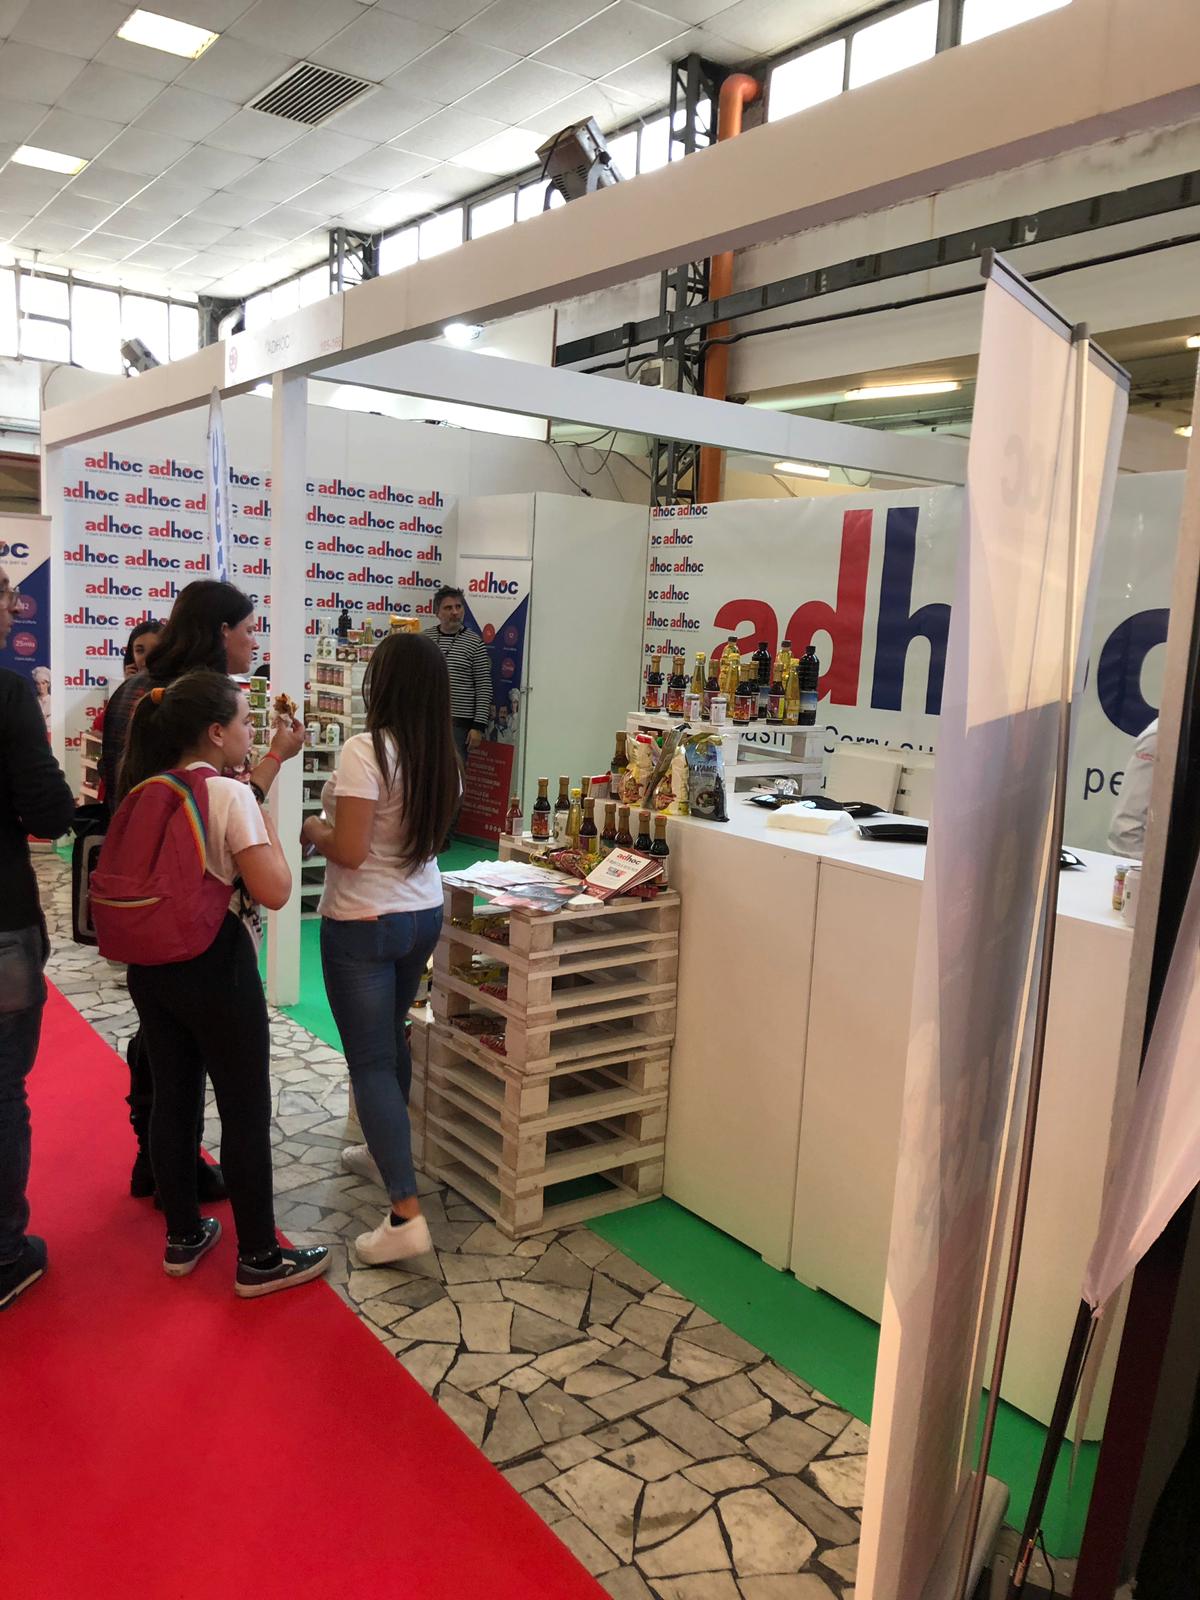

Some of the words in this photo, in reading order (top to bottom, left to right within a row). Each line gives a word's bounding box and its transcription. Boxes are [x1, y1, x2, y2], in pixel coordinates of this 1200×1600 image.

[85, 450, 143, 473] adhoc
[149, 459, 204, 480] adhoc
[229, 467, 260, 487] hoc
[318, 479, 366, 498] adhoc
[369, 485, 414, 504] adhoc
[125, 487, 181, 508] adhoc
[243, 500, 272, 517] adh
[307, 505, 346, 525] dhoc
[349, 511, 395, 529] adhoc
[399, 516, 443, 535] adhoc
[677, 504, 708, 517] adhoc
[85, 515, 143, 535] adhoc
[149, 520, 204, 541] adhoc
[317, 536, 364, 555] adhoc
[367, 541, 413, 559] adhoc
[663, 528, 693, 545] adhoc
[125, 549, 181, 569] adhoc
[242, 558, 272, 576] adh
[306, 563, 344, 581] dhoc
[348, 567, 393, 585] adhoc
[398, 571, 441, 588] adhoc
[674, 556, 704, 573] adhoc
[468, 571, 519, 595] adhoc
[85, 577, 143, 597] adhoc
[316, 592, 363, 610] adhoc
[367, 596, 411, 613] adhoc
[660, 584, 689, 601] adhoc
[670, 612, 700, 629] adhoc
[656, 639, 686, 656] adhoc
[64, 669, 108, 686] adho
[616, 853, 642, 866] adhoc
